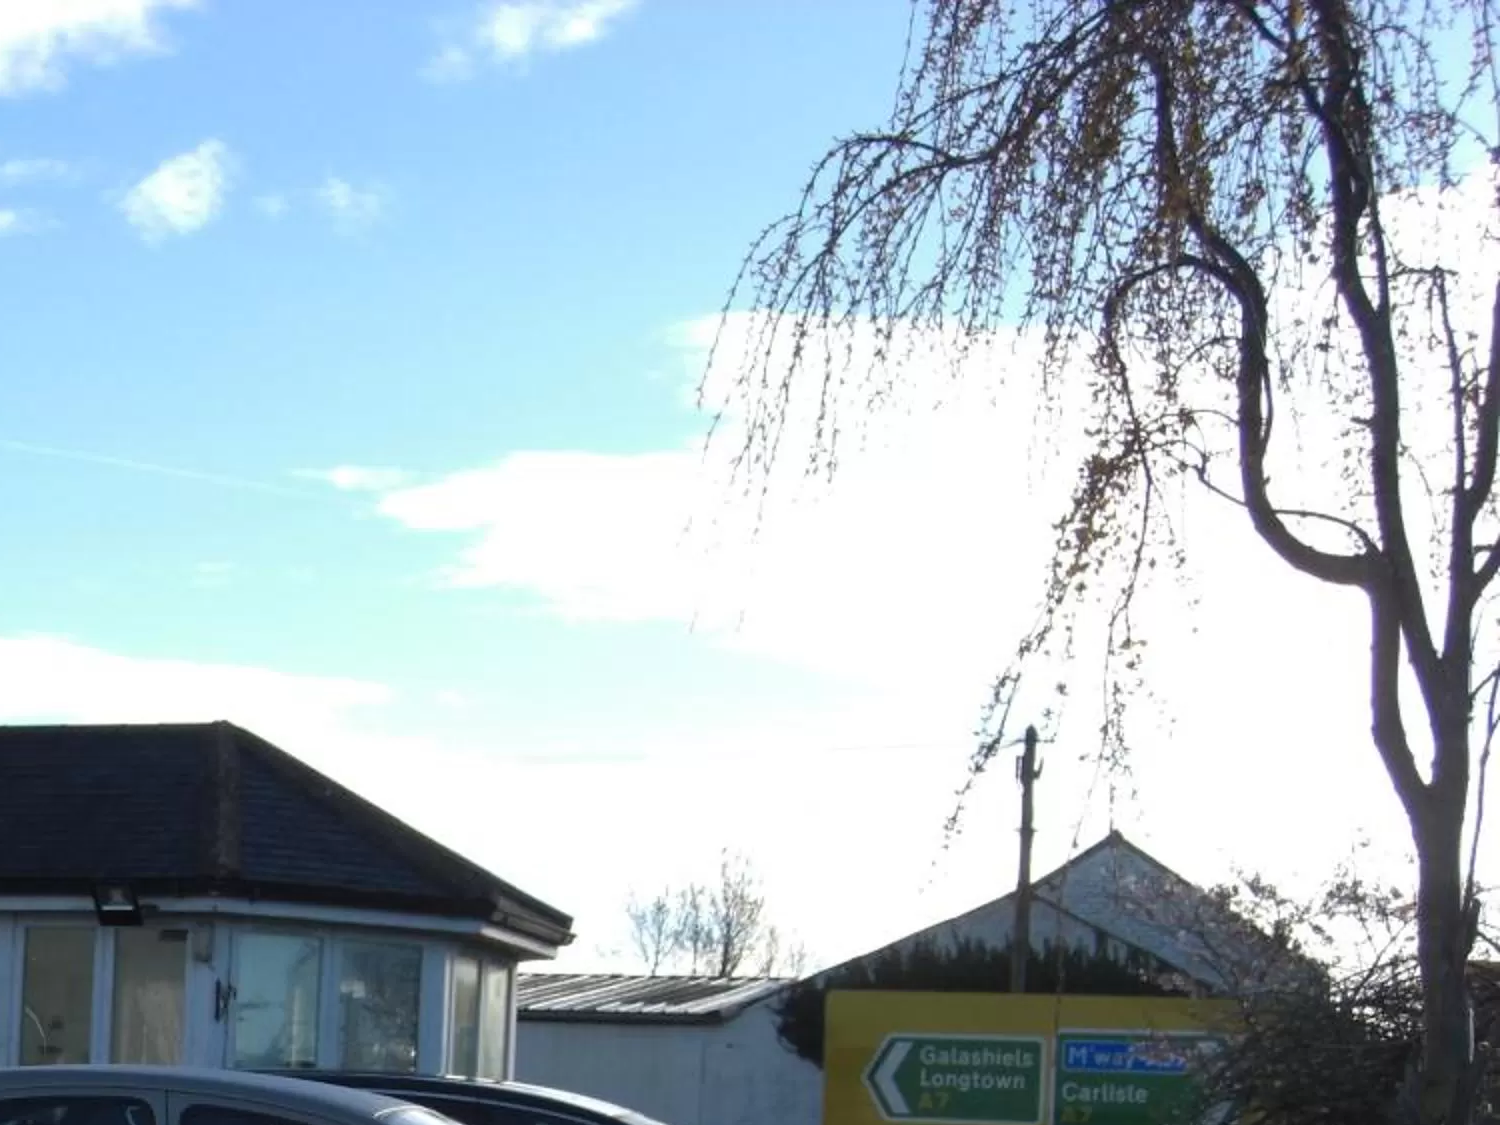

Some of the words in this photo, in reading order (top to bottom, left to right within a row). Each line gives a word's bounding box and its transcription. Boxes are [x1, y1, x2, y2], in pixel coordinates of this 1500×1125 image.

[919, 1044, 1034, 1069] Galashiels
[919, 1068, 1025, 1092] Longtown
[918, 1092, 949, 1110] A7
[1061, 1082, 1149, 1105] Carlisle
[1061, 1105, 1093, 1123] A7
